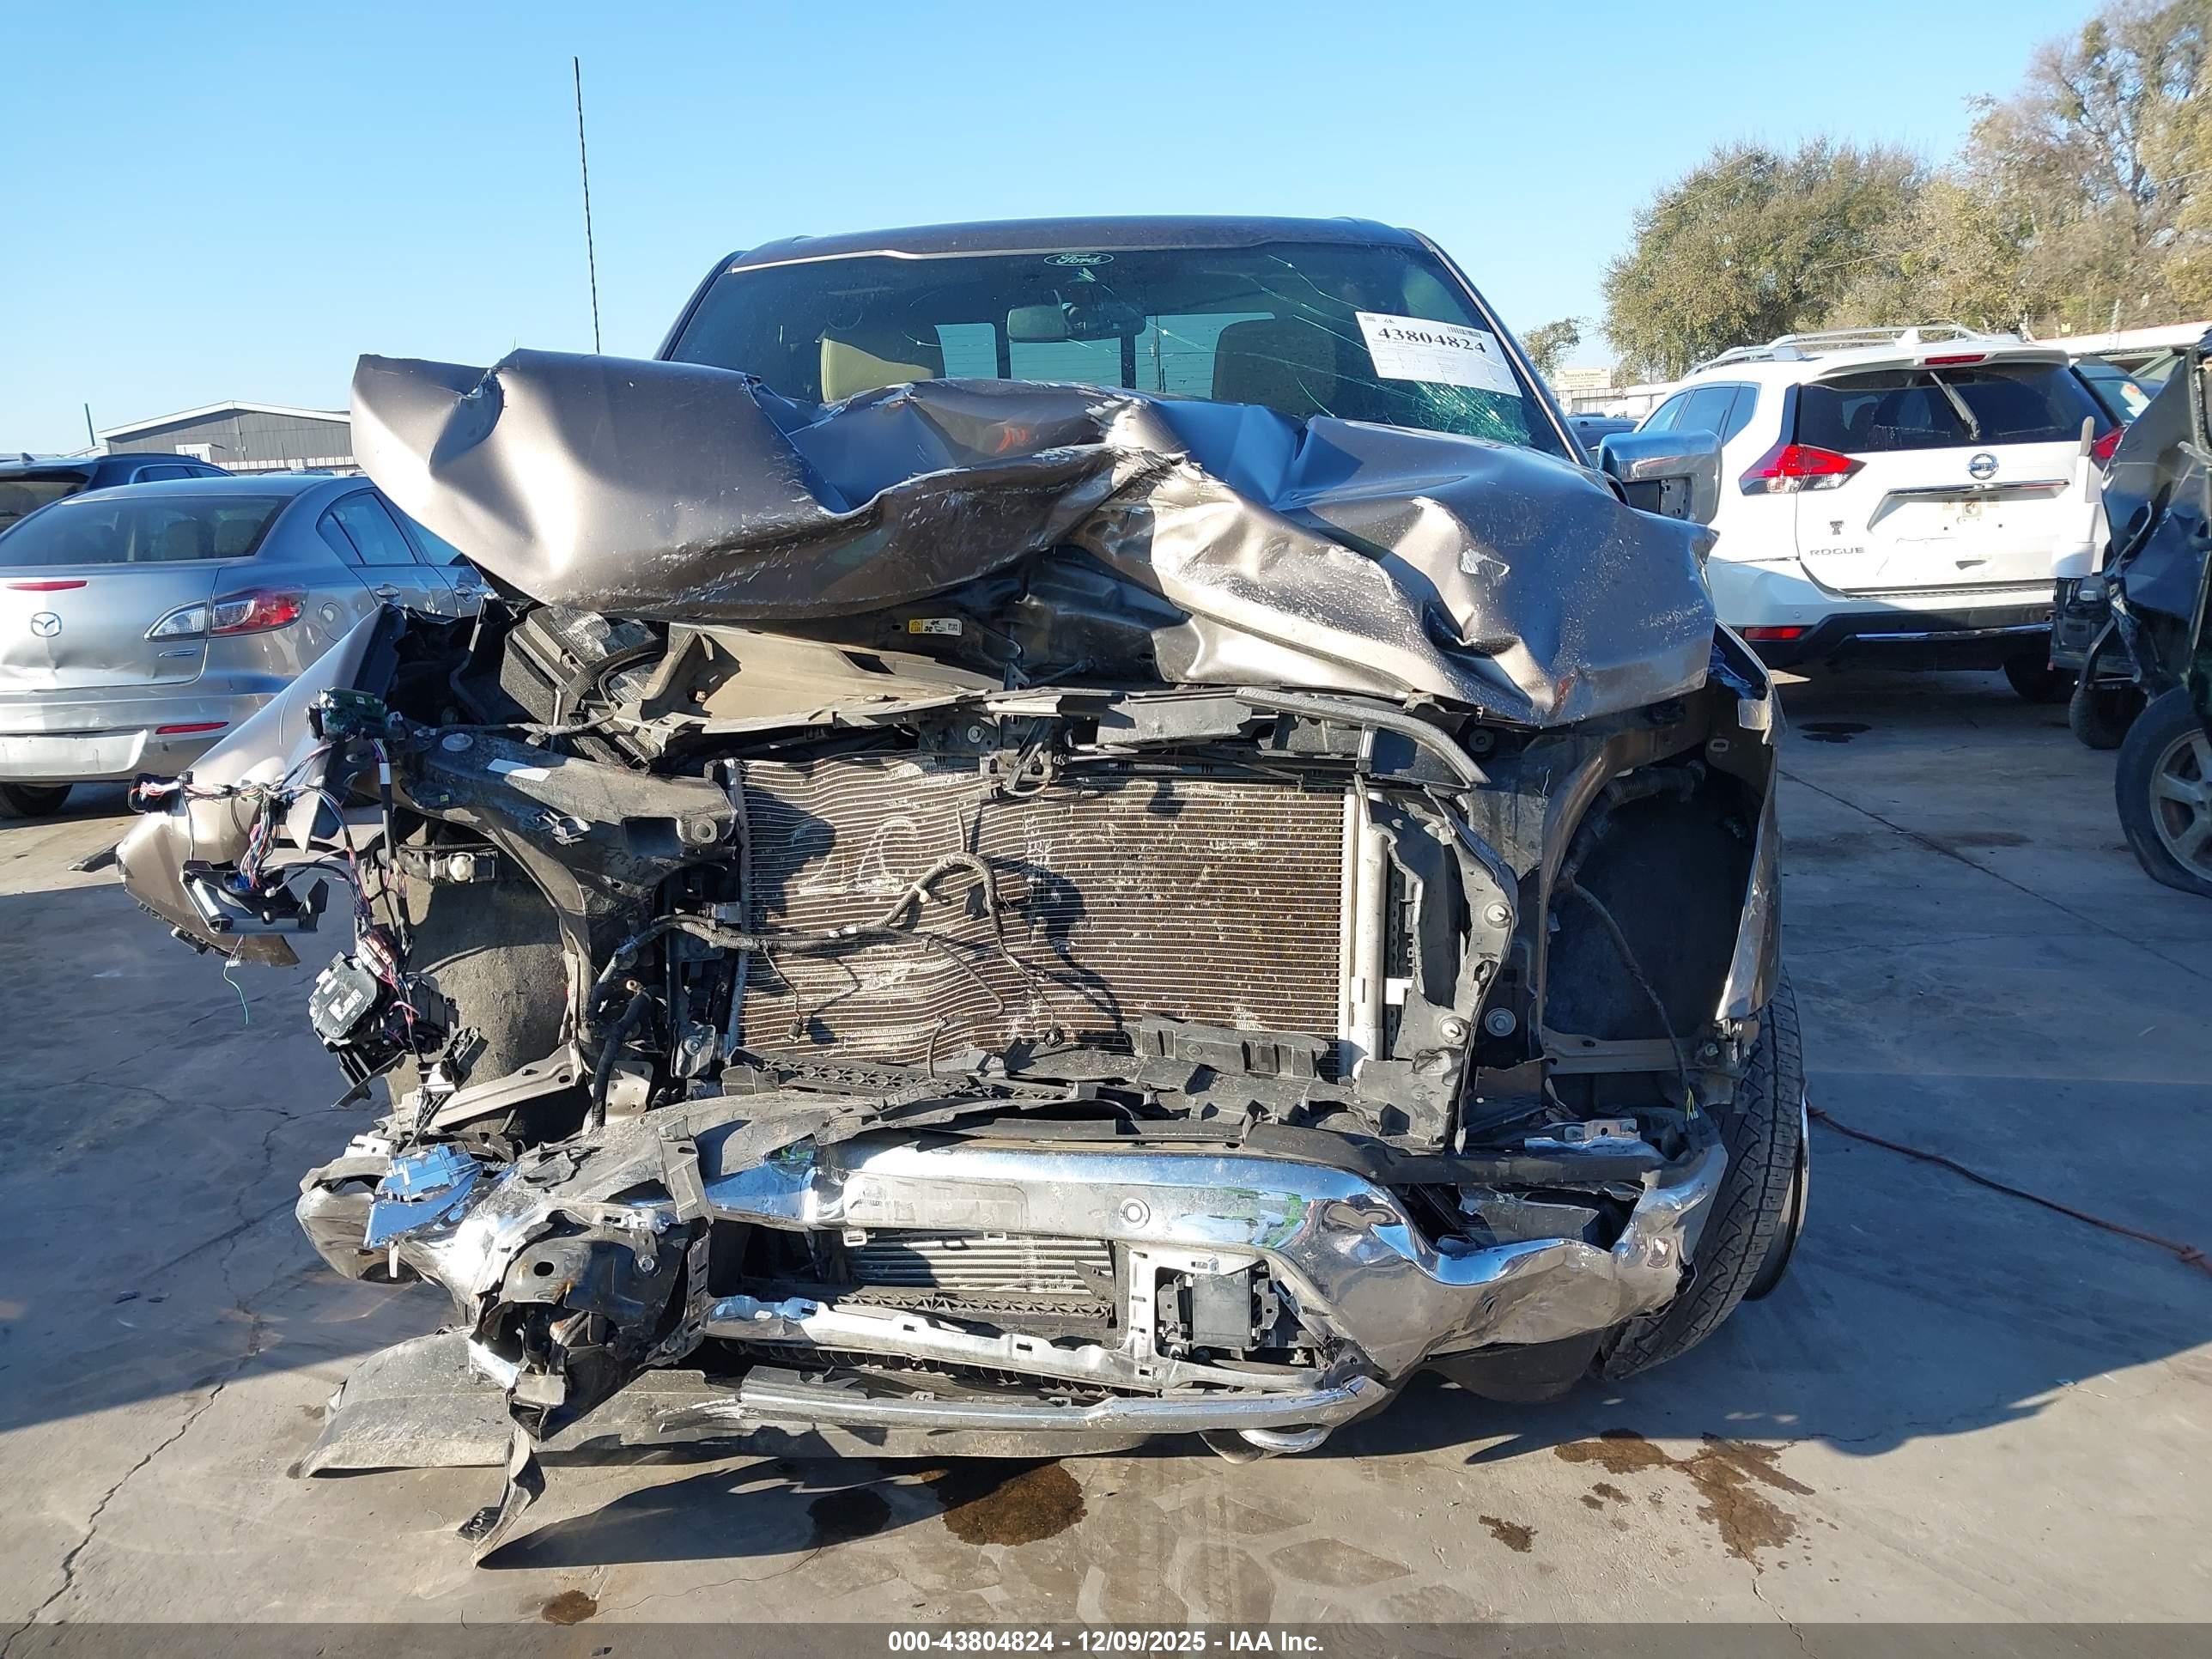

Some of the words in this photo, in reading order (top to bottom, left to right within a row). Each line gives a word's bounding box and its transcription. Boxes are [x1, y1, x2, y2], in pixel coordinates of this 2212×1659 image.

[1056, 253, 1101, 264] Ford
[1377, 327, 1487, 354] 43804824
[1809, 547, 1865, 556] ROGUE
